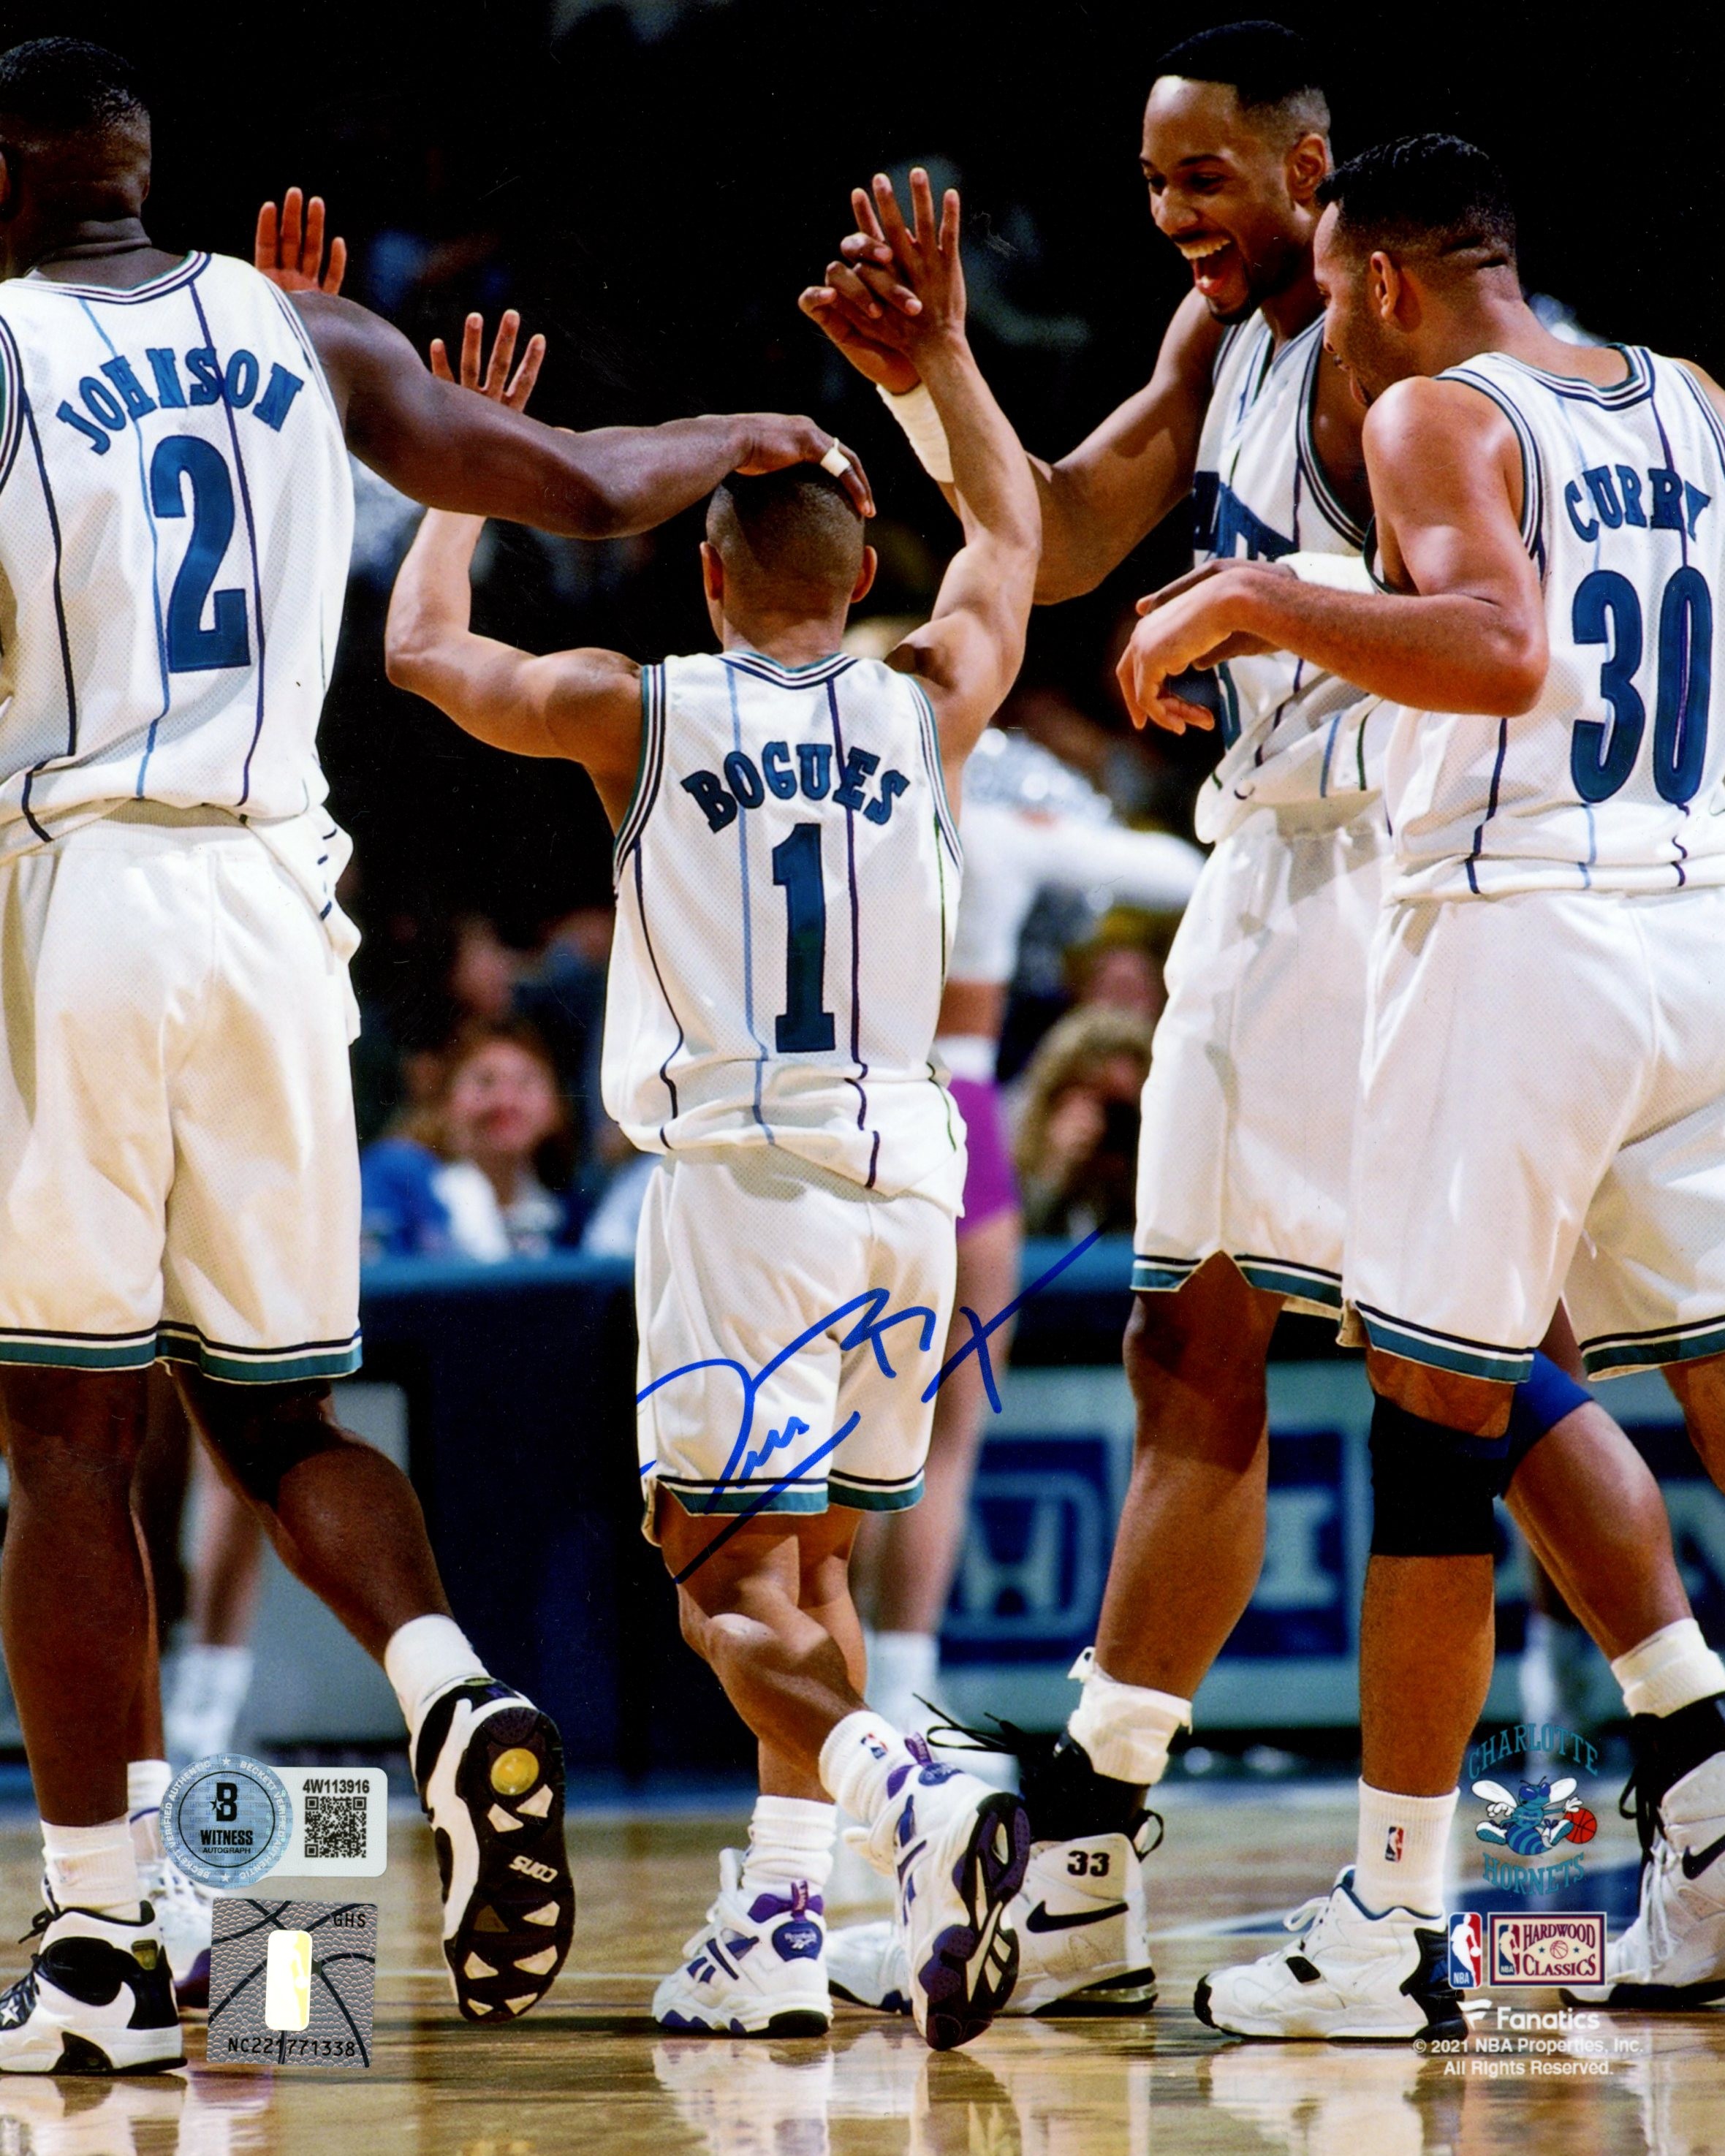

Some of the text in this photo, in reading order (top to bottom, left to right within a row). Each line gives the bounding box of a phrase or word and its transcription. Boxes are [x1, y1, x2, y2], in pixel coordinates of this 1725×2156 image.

[56, 348, 305, 456] JOHNSON
[150, 435, 251, 673] 2
[1563, 465, 1712, 543] CURRY
[1571, 566, 1713, 805] 30
[680, 741, 910, 832] BOGUES
[773, 822, 835, 1052] 1
[1067, 1851, 1110, 1877] 33
